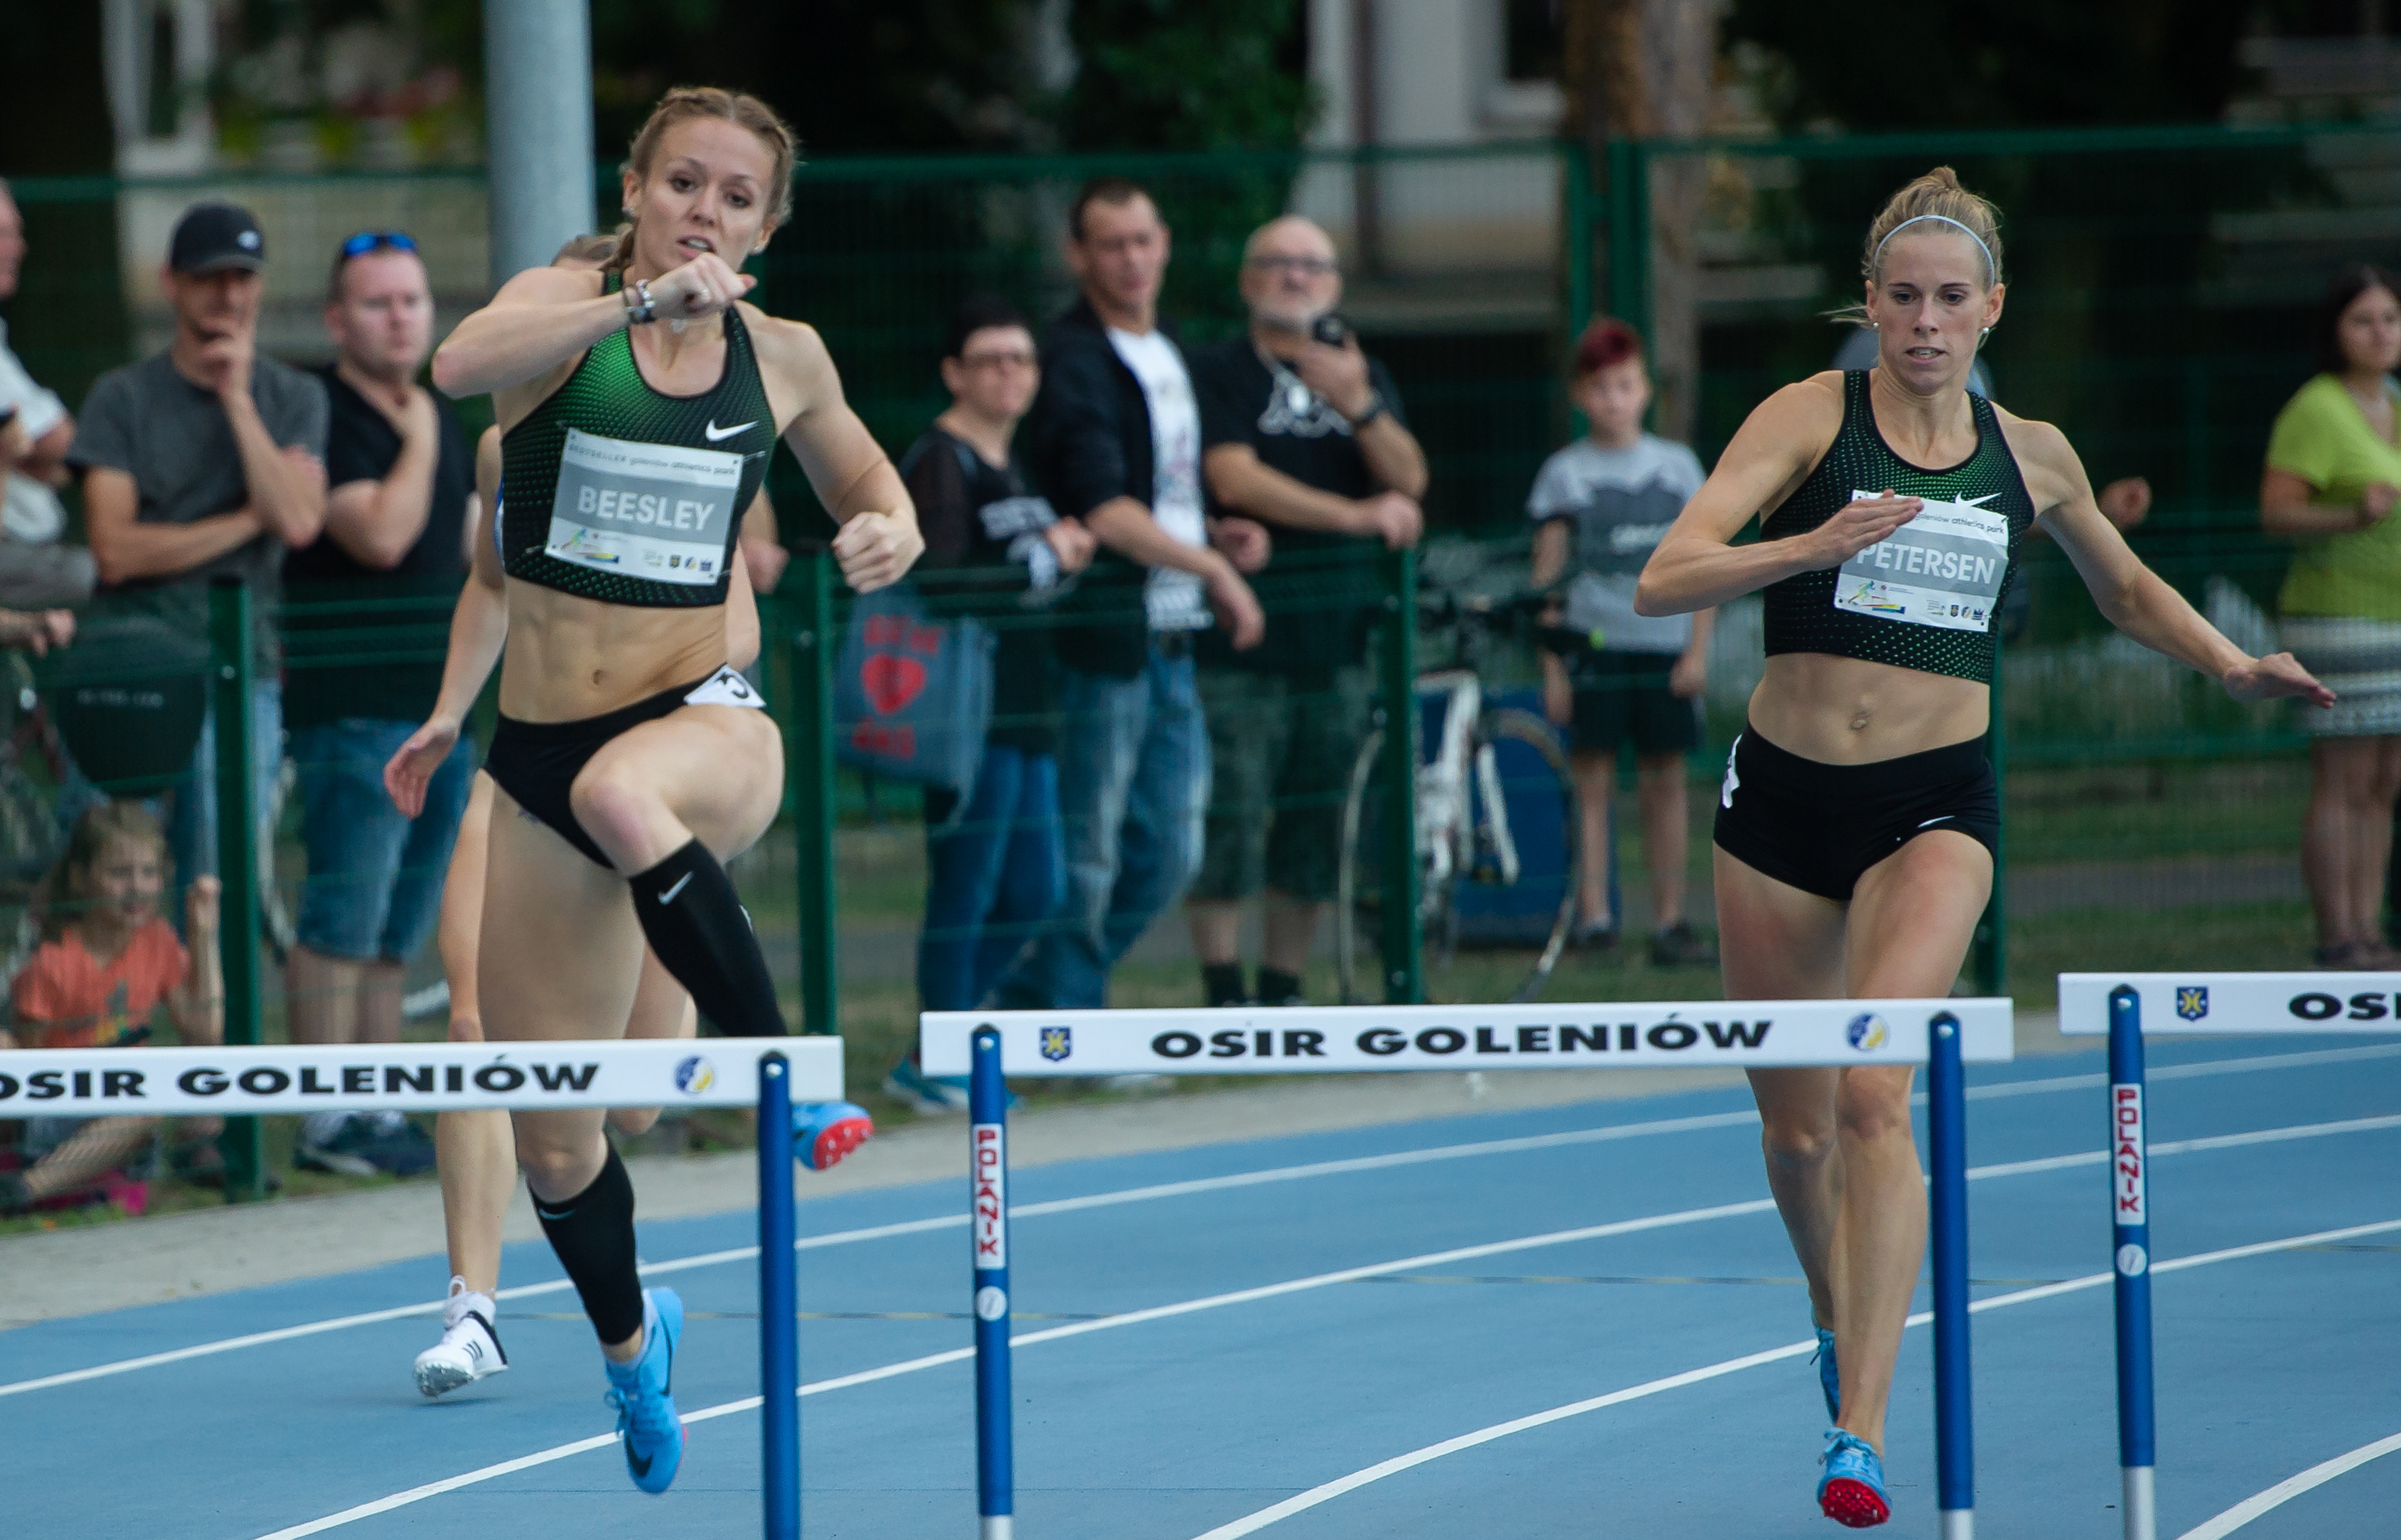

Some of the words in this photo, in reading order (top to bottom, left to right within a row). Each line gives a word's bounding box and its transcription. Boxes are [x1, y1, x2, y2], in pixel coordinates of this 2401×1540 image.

[579, 485, 715, 531] BEESLEY
[1856, 541, 1996, 585] PETERSEN
[1152, 1029, 1328, 1059] OSIR
[1357, 1012, 1773, 1056] GOLENIÓW
[177, 1053, 600, 1097] GOLENIÓW
[2117, 1088, 2141, 1212] POLANIK
[977, 1129, 999, 1256] POLANIK
